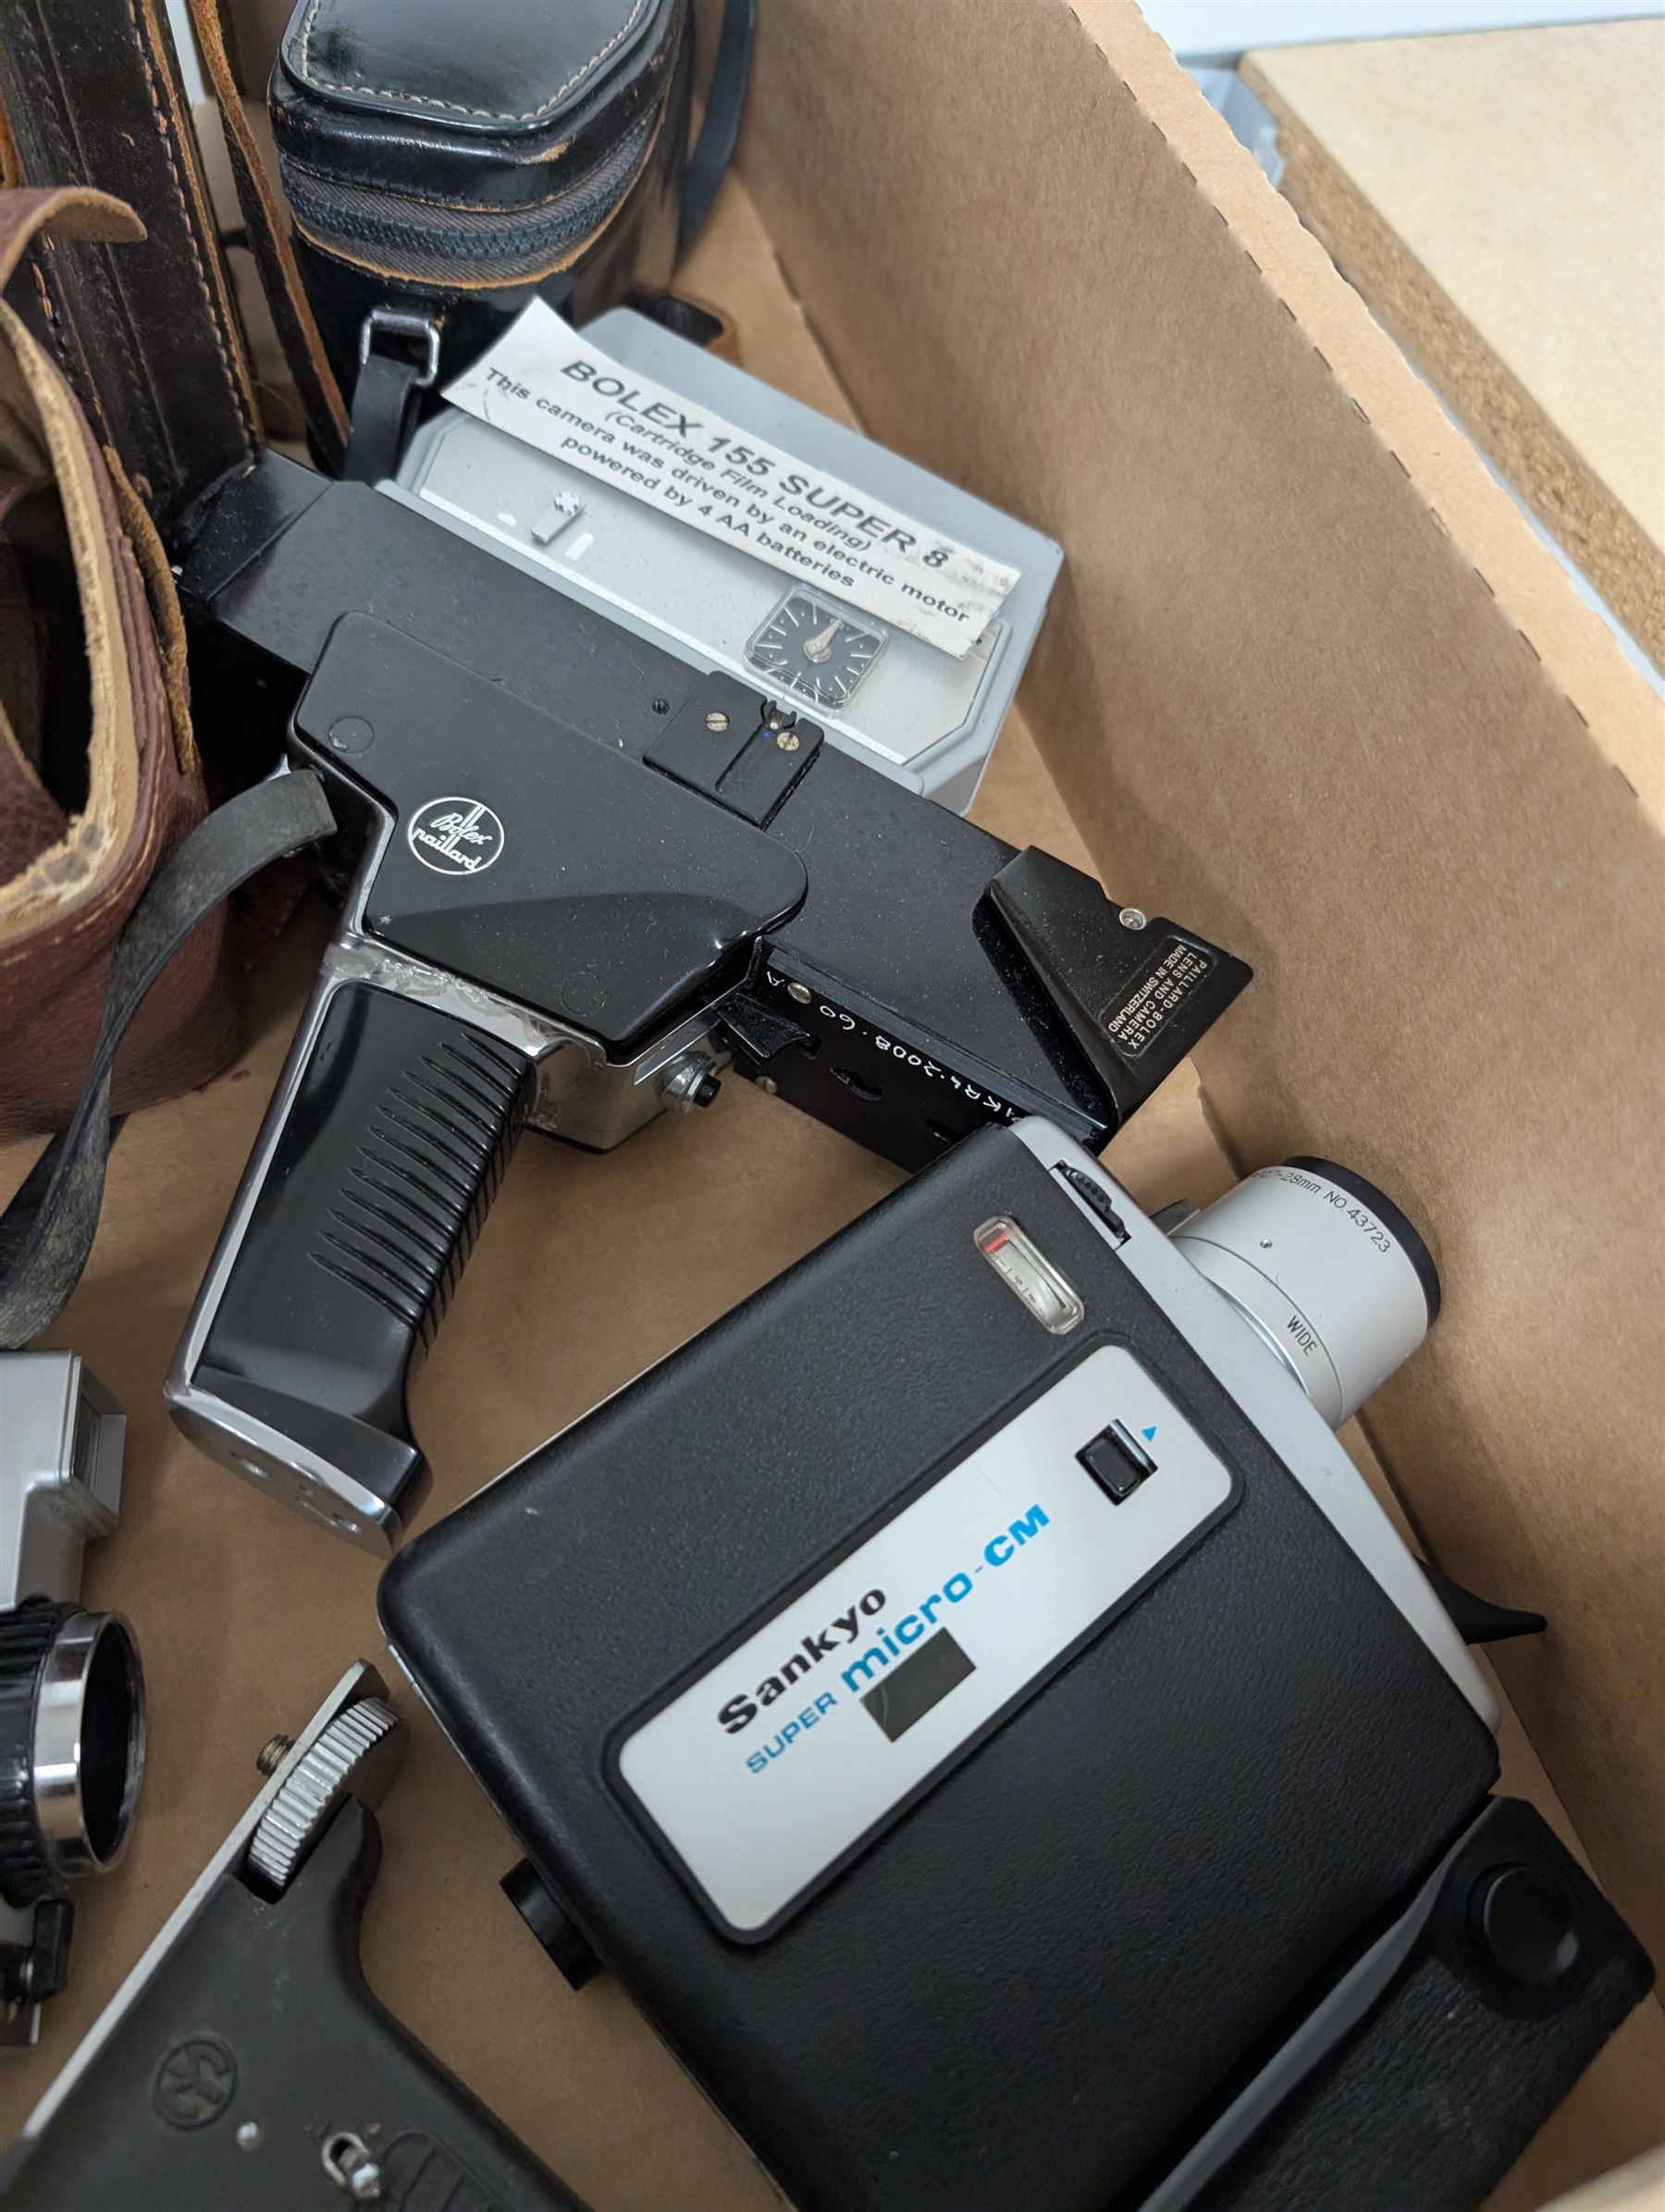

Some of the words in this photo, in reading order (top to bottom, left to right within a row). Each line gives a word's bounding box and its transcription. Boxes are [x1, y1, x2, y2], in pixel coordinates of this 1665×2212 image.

[561, 361, 705, 439] BOLEX
[708, 437, 776, 476] 155
[779, 474, 917, 553] SUPER
[922, 550, 949, 569] 8
[605, 411, 716, 471] (Cartridge
[720, 468, 769, 498] Film
[772, 496, 870, 551] Loading)
[486, 367, 531, 400] This
[536, 398, 616, 444] camera
[623, 440, 664, 469] was
[672, 463, 741, 508] driven
[746, 503, 775, 525] by
[779, 523, 808, 542] an
[813, 538, 894, 585] electric
[901, 583, 969, 623] motor
[560, 437, 660, 489] powered
[663, 485, 694, 507] by
[697, 505, 714, 518] 4
[716, 513, 750, 537] AA
[756, 533, 855, 587] batteries
[1154, 967, 1167, 979] IN
[1163, 944, 1187, 969] MADE
[1172, 952, 1197, 979] LENS
[1108, 977, 1159, 1032] SWITZERLAND
[1153, 978, 1174, 999] AND
[1117, 1000, 1155, 1040] CAMERA
[1347, 1208, 1390, 1253] 43723
[1287, 1315, 1317, 1356] WIDE
[717, 1588, 886, 1734] Sankyo
[745, 1691, 837, 1773] SUPER
[840, 1503, 1050, 1692] micro-CM
